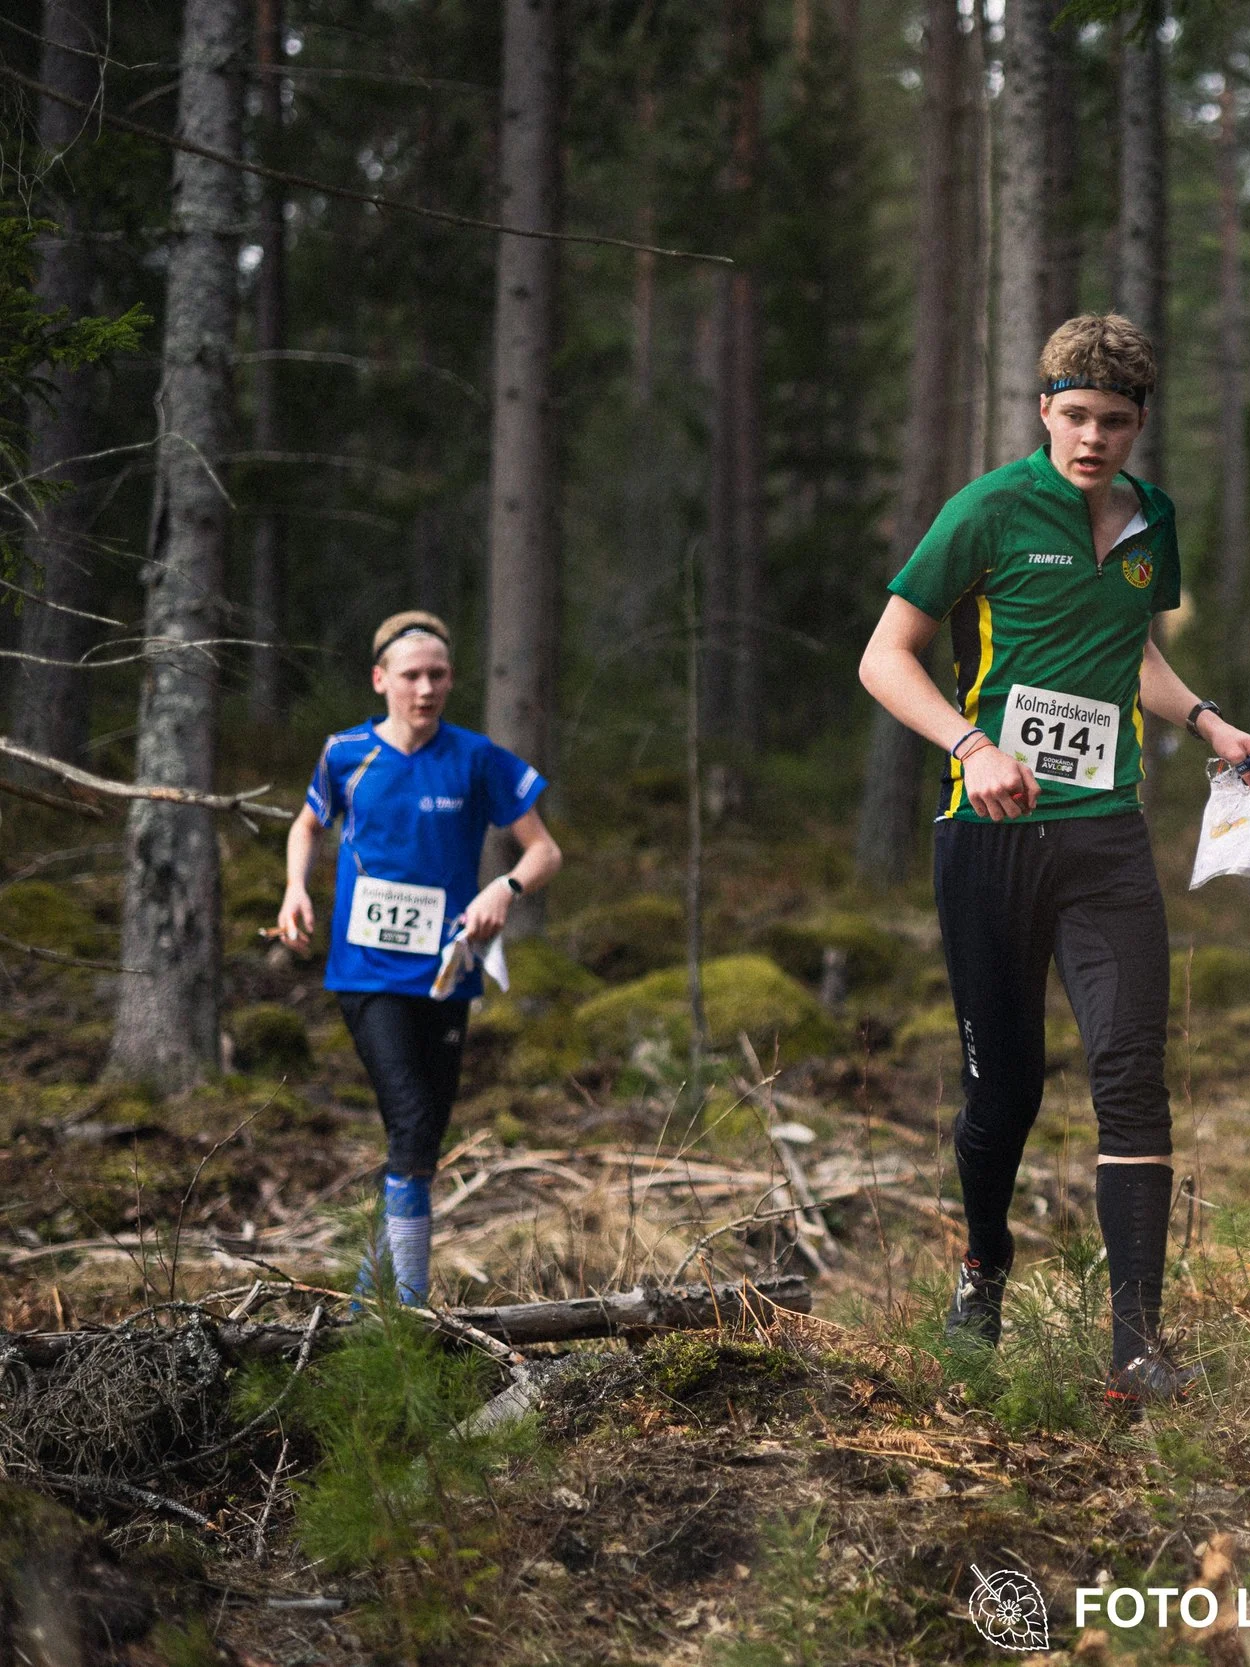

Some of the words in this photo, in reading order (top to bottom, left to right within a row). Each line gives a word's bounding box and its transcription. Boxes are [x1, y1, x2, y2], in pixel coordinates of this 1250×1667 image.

[1028, 553, 1073, 565] TRIMTEX
[1015, 693, 1111, 728] Kolmårdskavlen
[1020, 716, 1091, 756] 614
[1095, 743, 1105, 760] 1
[366, 902, 421, 929] 612
